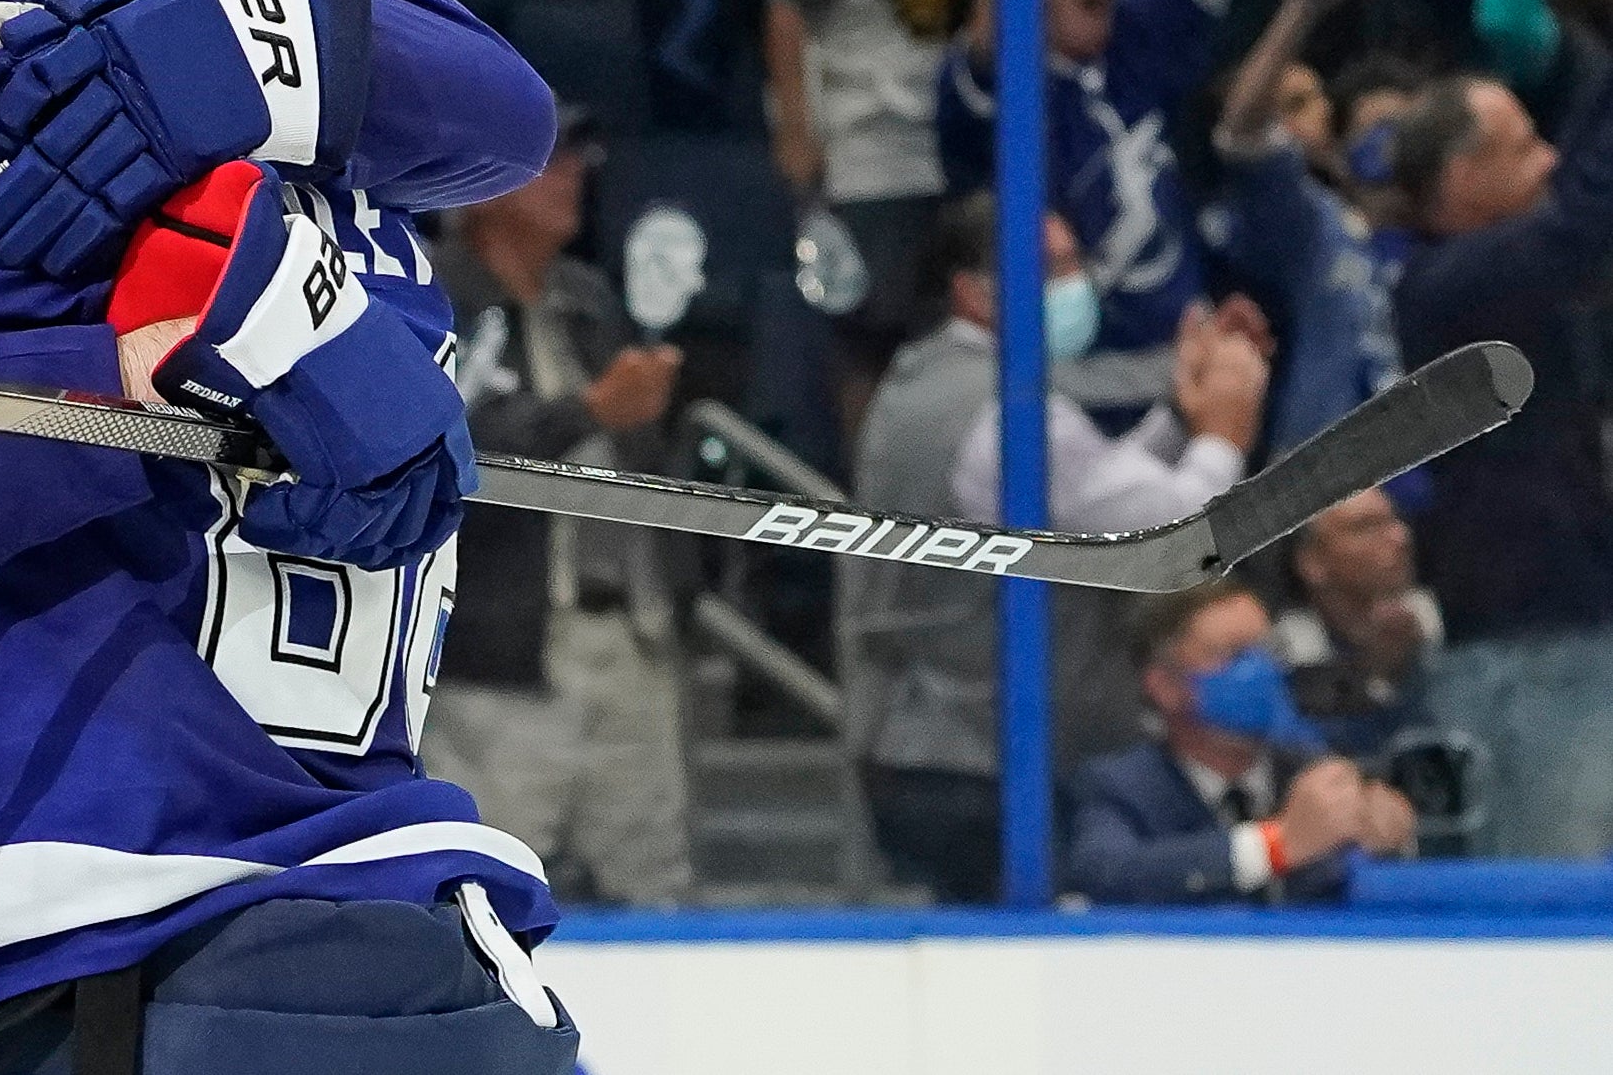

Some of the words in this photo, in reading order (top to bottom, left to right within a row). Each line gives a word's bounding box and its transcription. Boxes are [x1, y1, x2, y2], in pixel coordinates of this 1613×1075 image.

[180, 379, 242, 408] HEDMAN
[140, 399, 204, 420] HEDMAN
[745, 504, 1034, 574] BAUER
